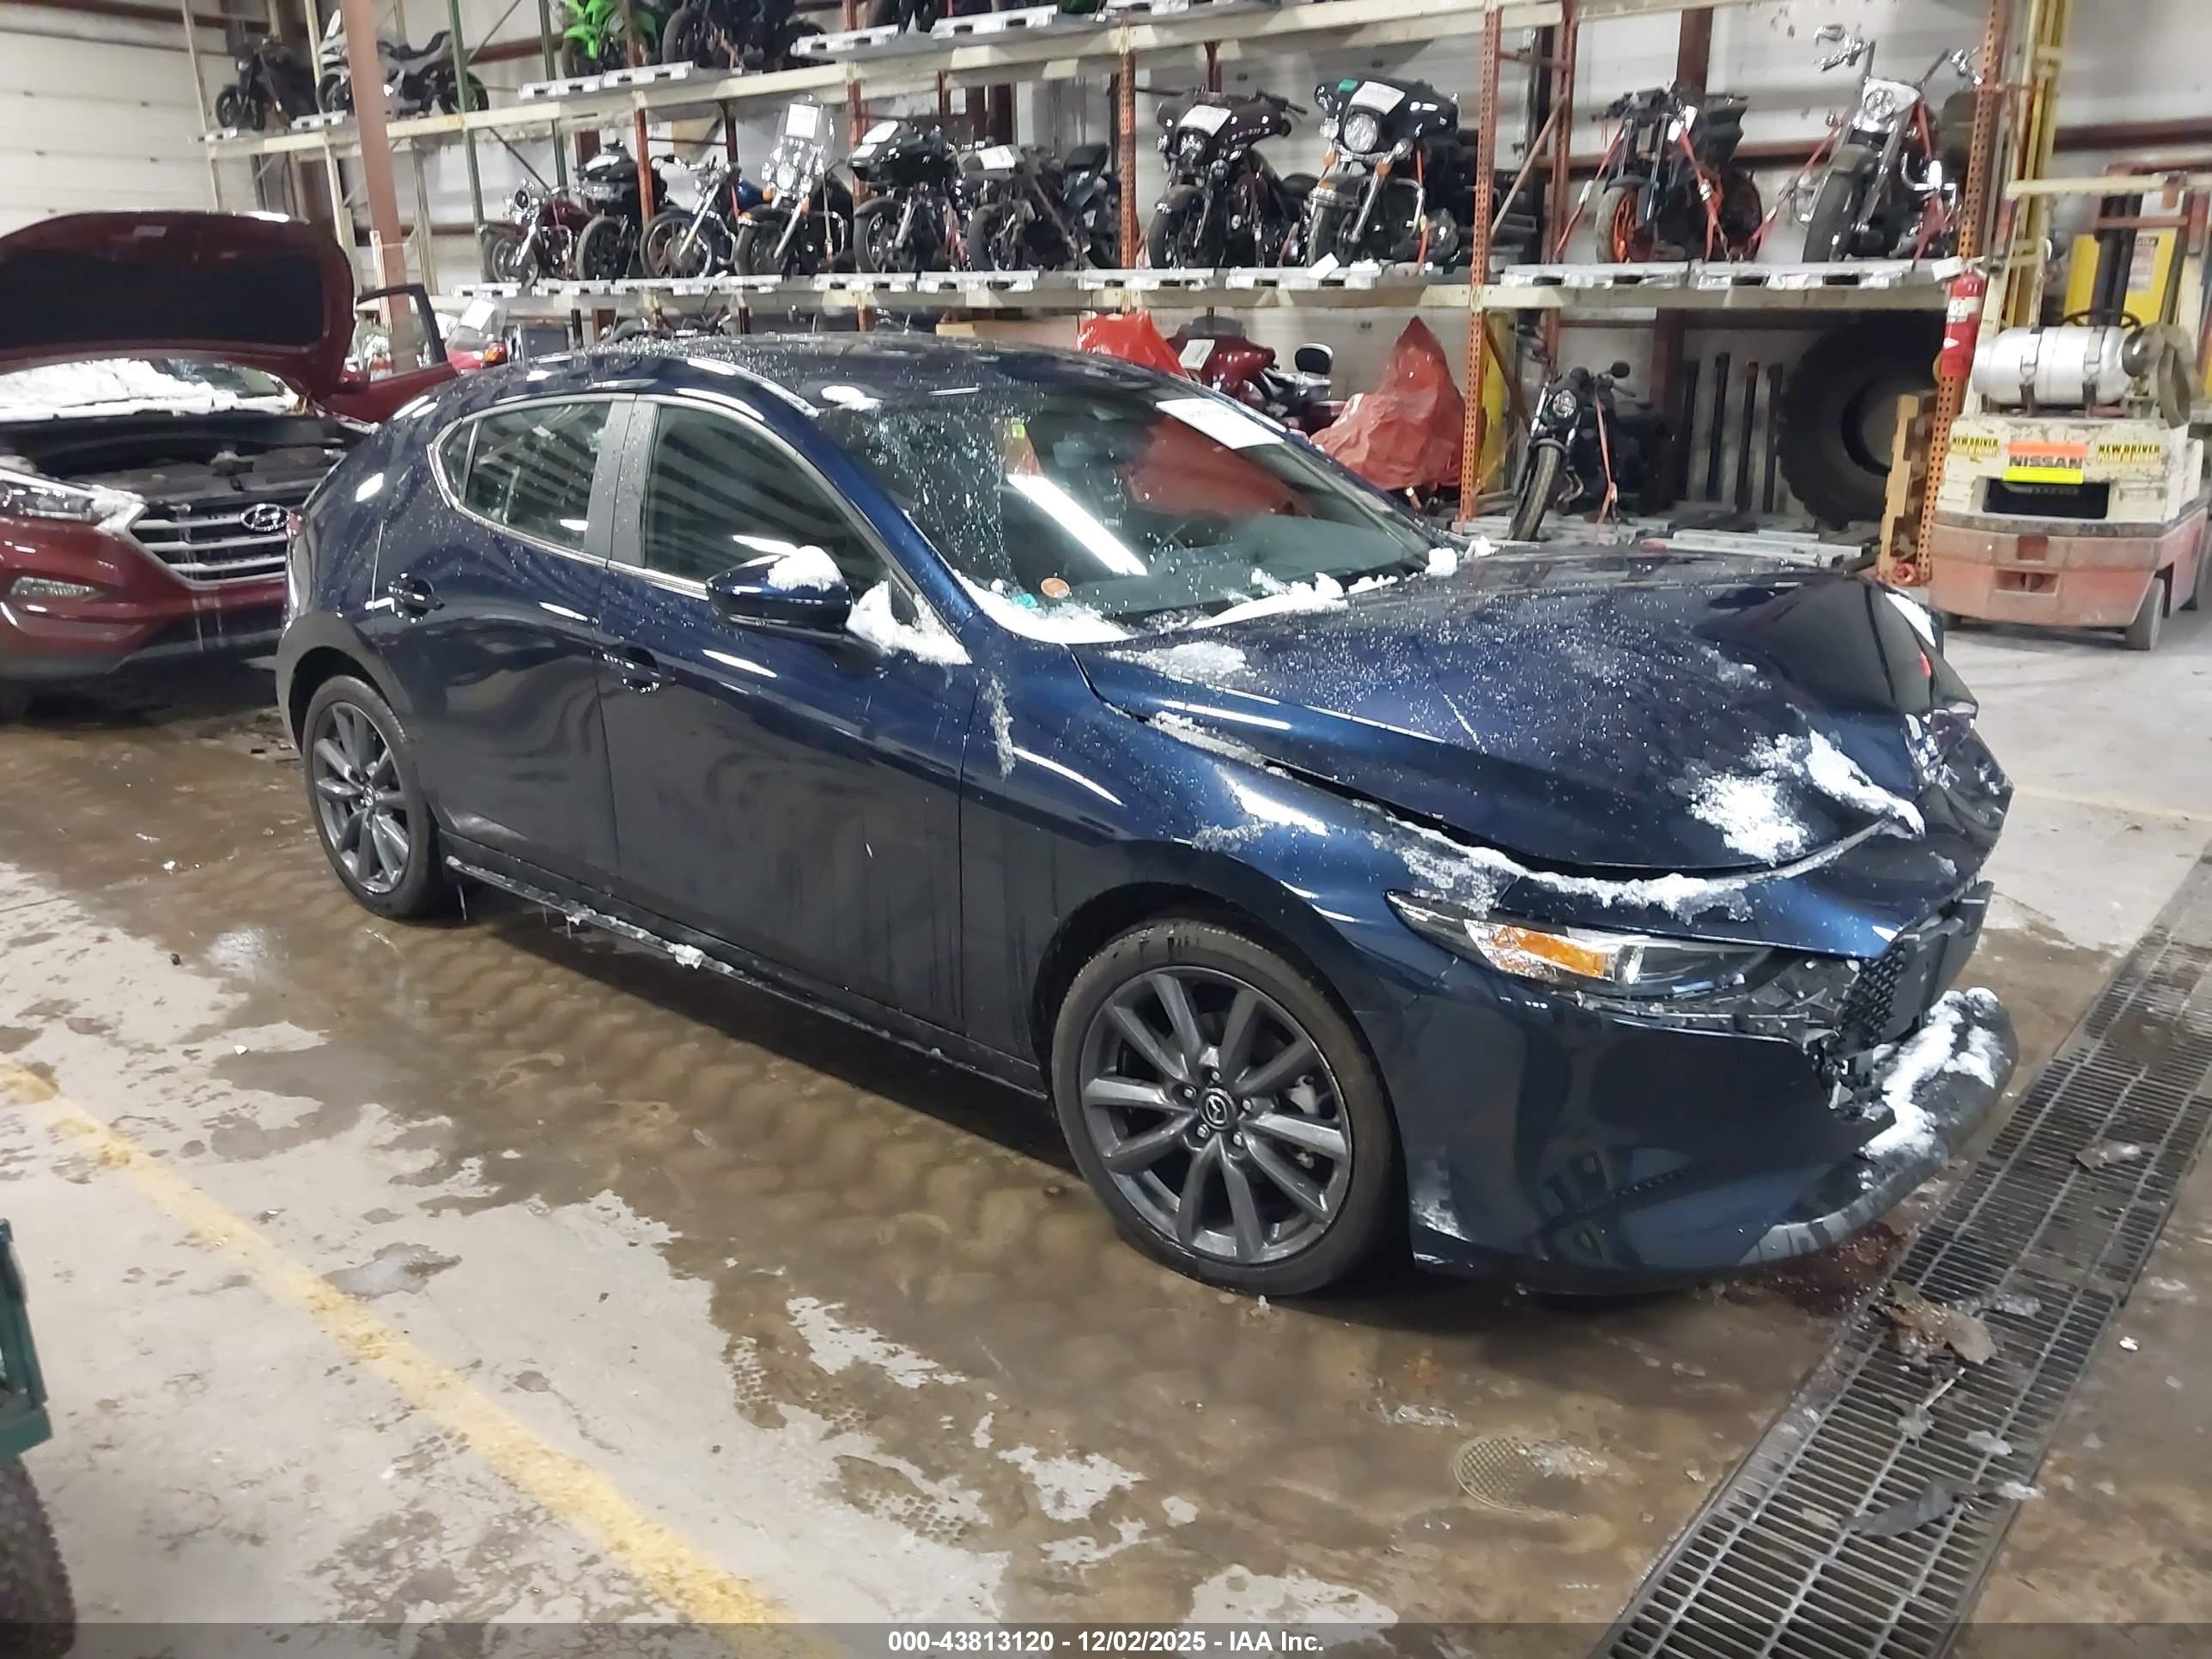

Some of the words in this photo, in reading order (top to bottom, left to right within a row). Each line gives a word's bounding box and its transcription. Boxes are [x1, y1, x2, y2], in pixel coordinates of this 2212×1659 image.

[2098, 443, 2122, 453] NEW
[2124, 444, 2160, 453] DRIVER
[2008, 455, 2083, 470] NISSAN
